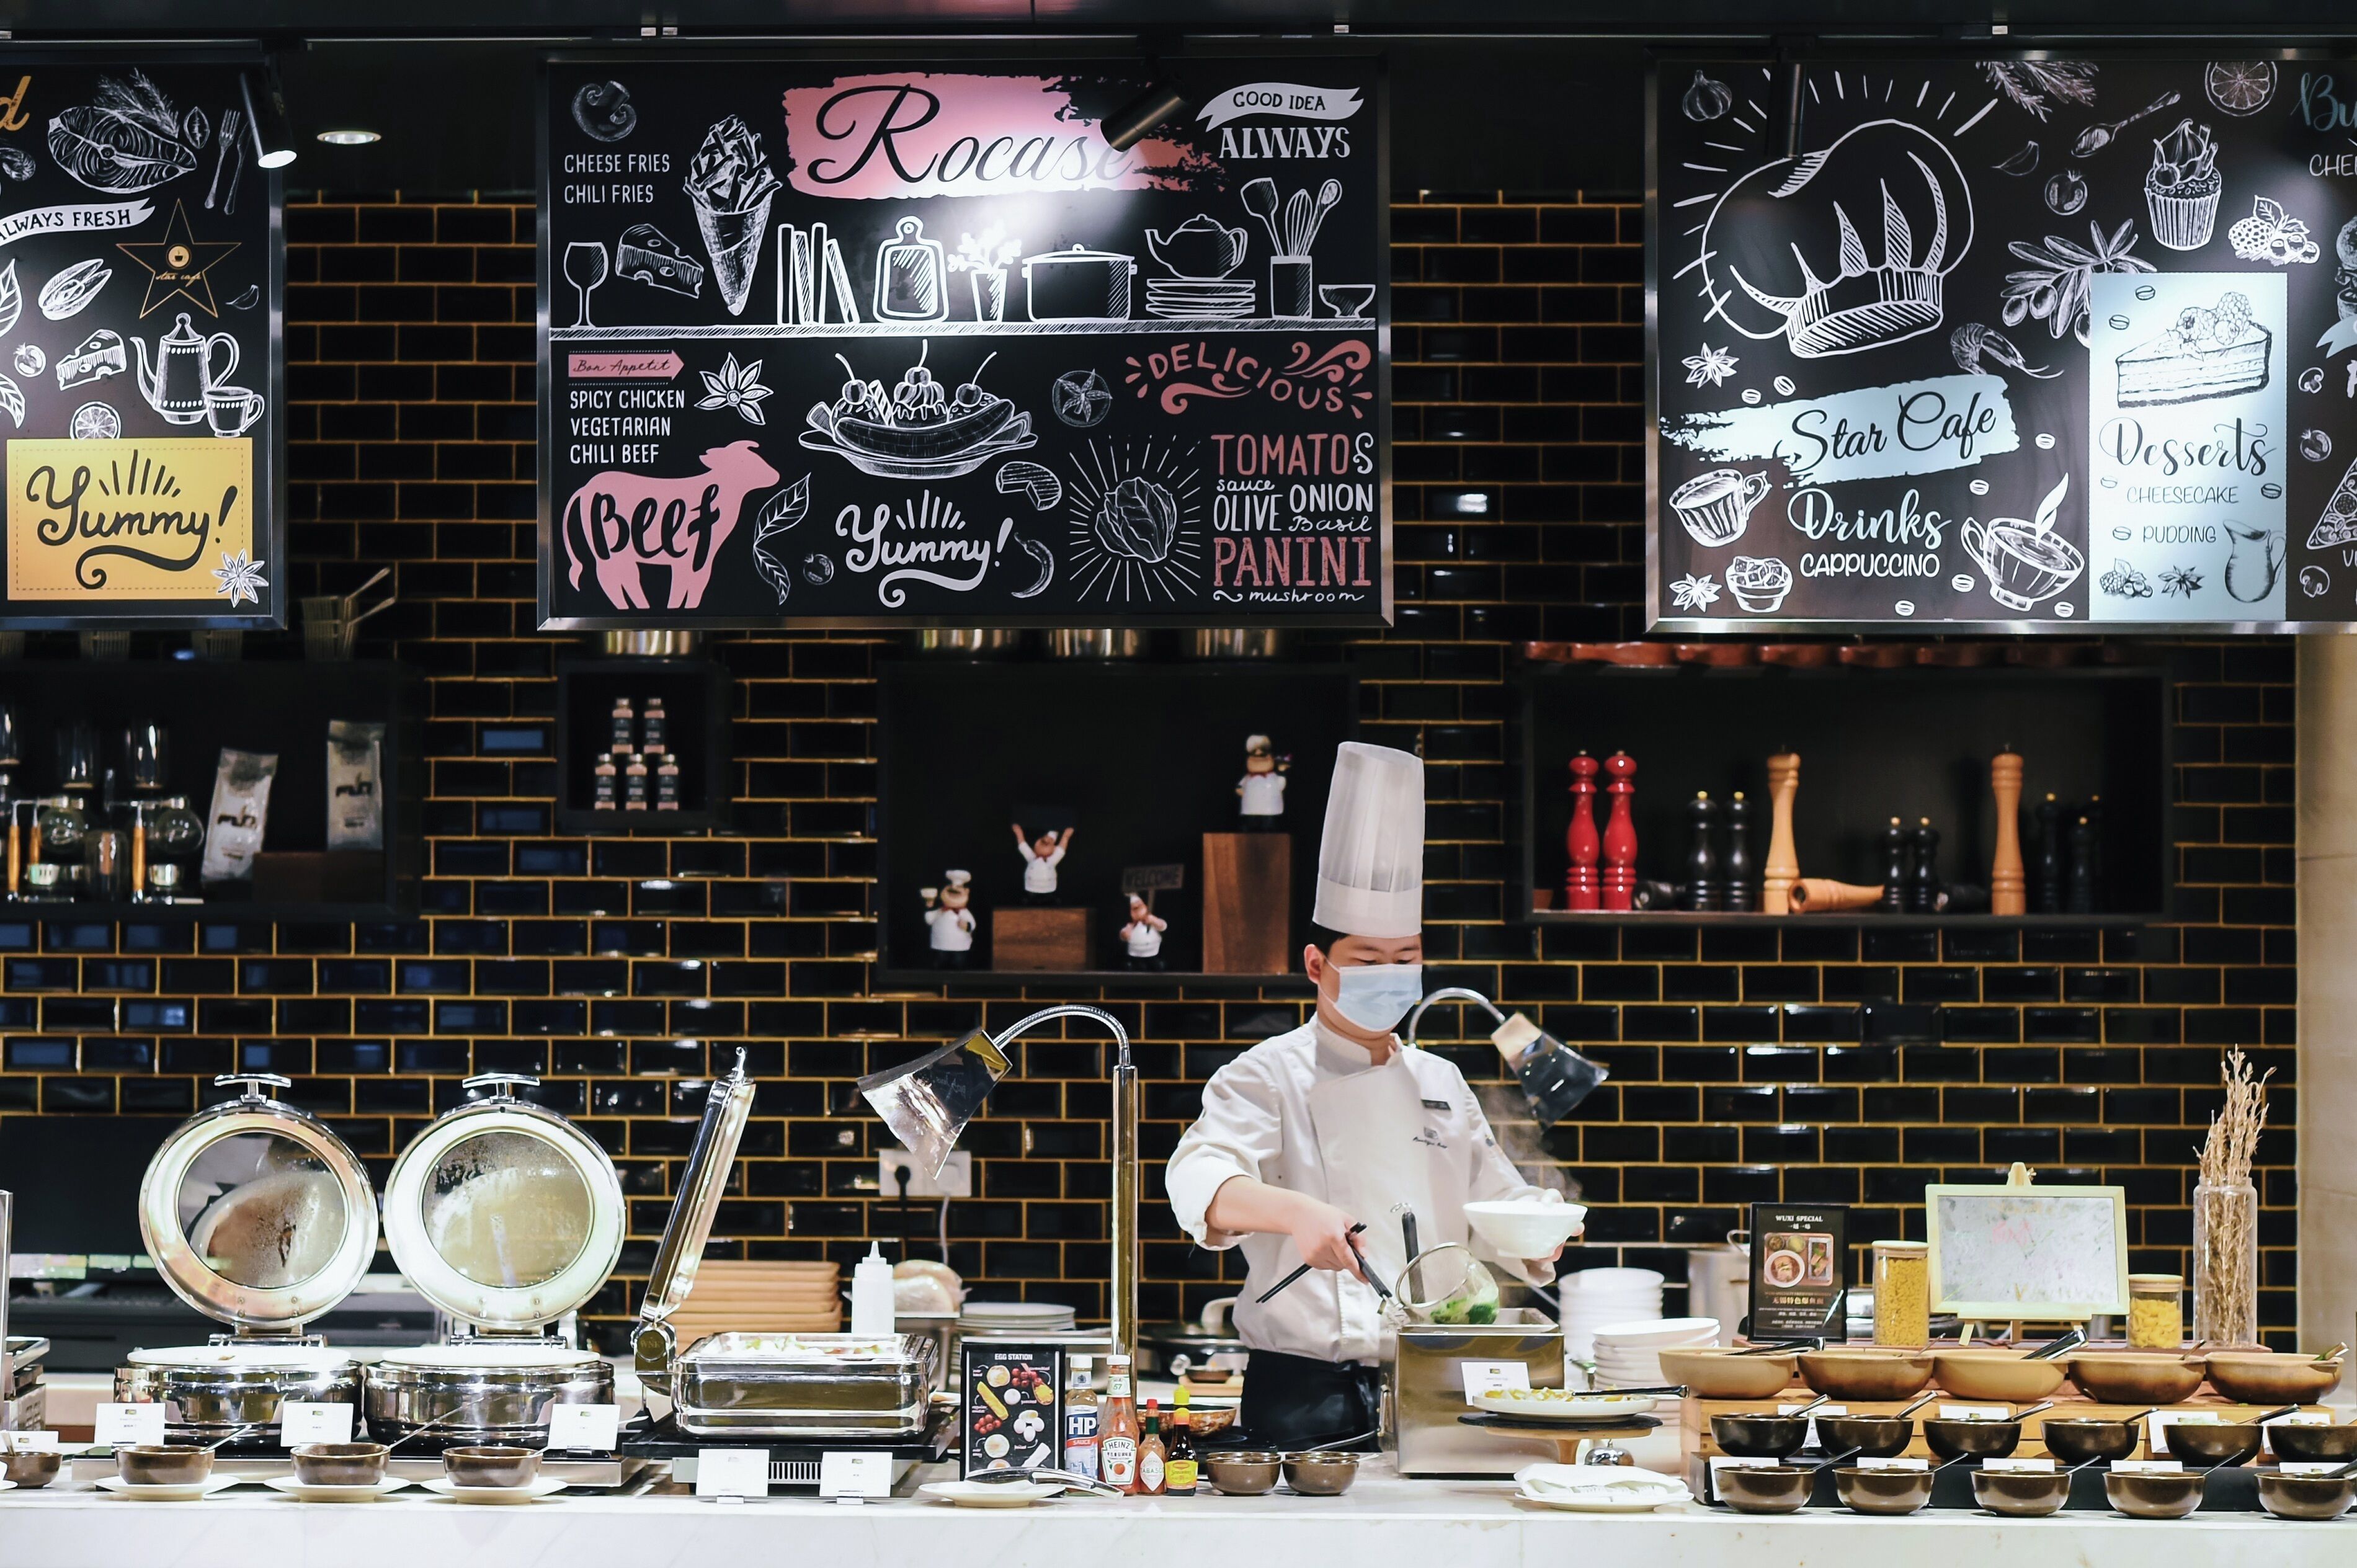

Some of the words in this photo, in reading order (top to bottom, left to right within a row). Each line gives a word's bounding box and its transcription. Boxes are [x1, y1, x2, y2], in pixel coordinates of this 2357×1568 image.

[1232, 91, 1283, 108] GOOD
[1289, 95, 1326, 111] IDEA
[1219, 127, 1351, 159] ALWAYS
[564, 154, 621, 173] CHEESE
[628, 154, 670, 172] FRIES
[2309, 154, 2357, 177] CHE
[564, 185, 605, 203] CHILI
[612, 185, 654, 203] FRIES
[73, 208, 131, 227] FRESH
[573, 360, 606, 372] Bon
[610, 359, 671, 375] Appetit
[1148, 342, 1343, 413] DELICIOUS
[569, 391, 612, 409] SPICY
[618, 390, 685, 409] CHICKEN
[571, 417, 671, 437] VEGETARIAN
[1773, 409, 1887, 473] Star
[1897, 391, 1997, 460] Cafe
[570, 445, 615, 465] CHILI
[622, 445, 659, 464] BEEF
[2099, 417, 2277, 476] Desserts
[1216, 479, 1275, 492] sauce
[2126, 486, 2240, 504] CHEESECAKE
[1213, 494, 1283, 532] OLIVE
[1289, 484, 1374, 513] ONION
[26, 465, 238, 589] Yummy!
[589, 484, 720, 572] Beef
[1288, 515, 1373, 532] Basil
[1787, 488, 1953, 551] Drinks
[2143, 525, 2217, 543] PUDDING
[835, 504, 1014, 608] Yummy!
[1213, 537, 1372, 587] PANINI
[1800, 553, 1940, 578] CAPPUCCINO
[2343, 549, 2357, 567] V
[1249, 590, 1365, 603] mushroom
[1069, 1417, 1097, 1435] HP
[1108, 1441, 1131, 1450] HEINZ
